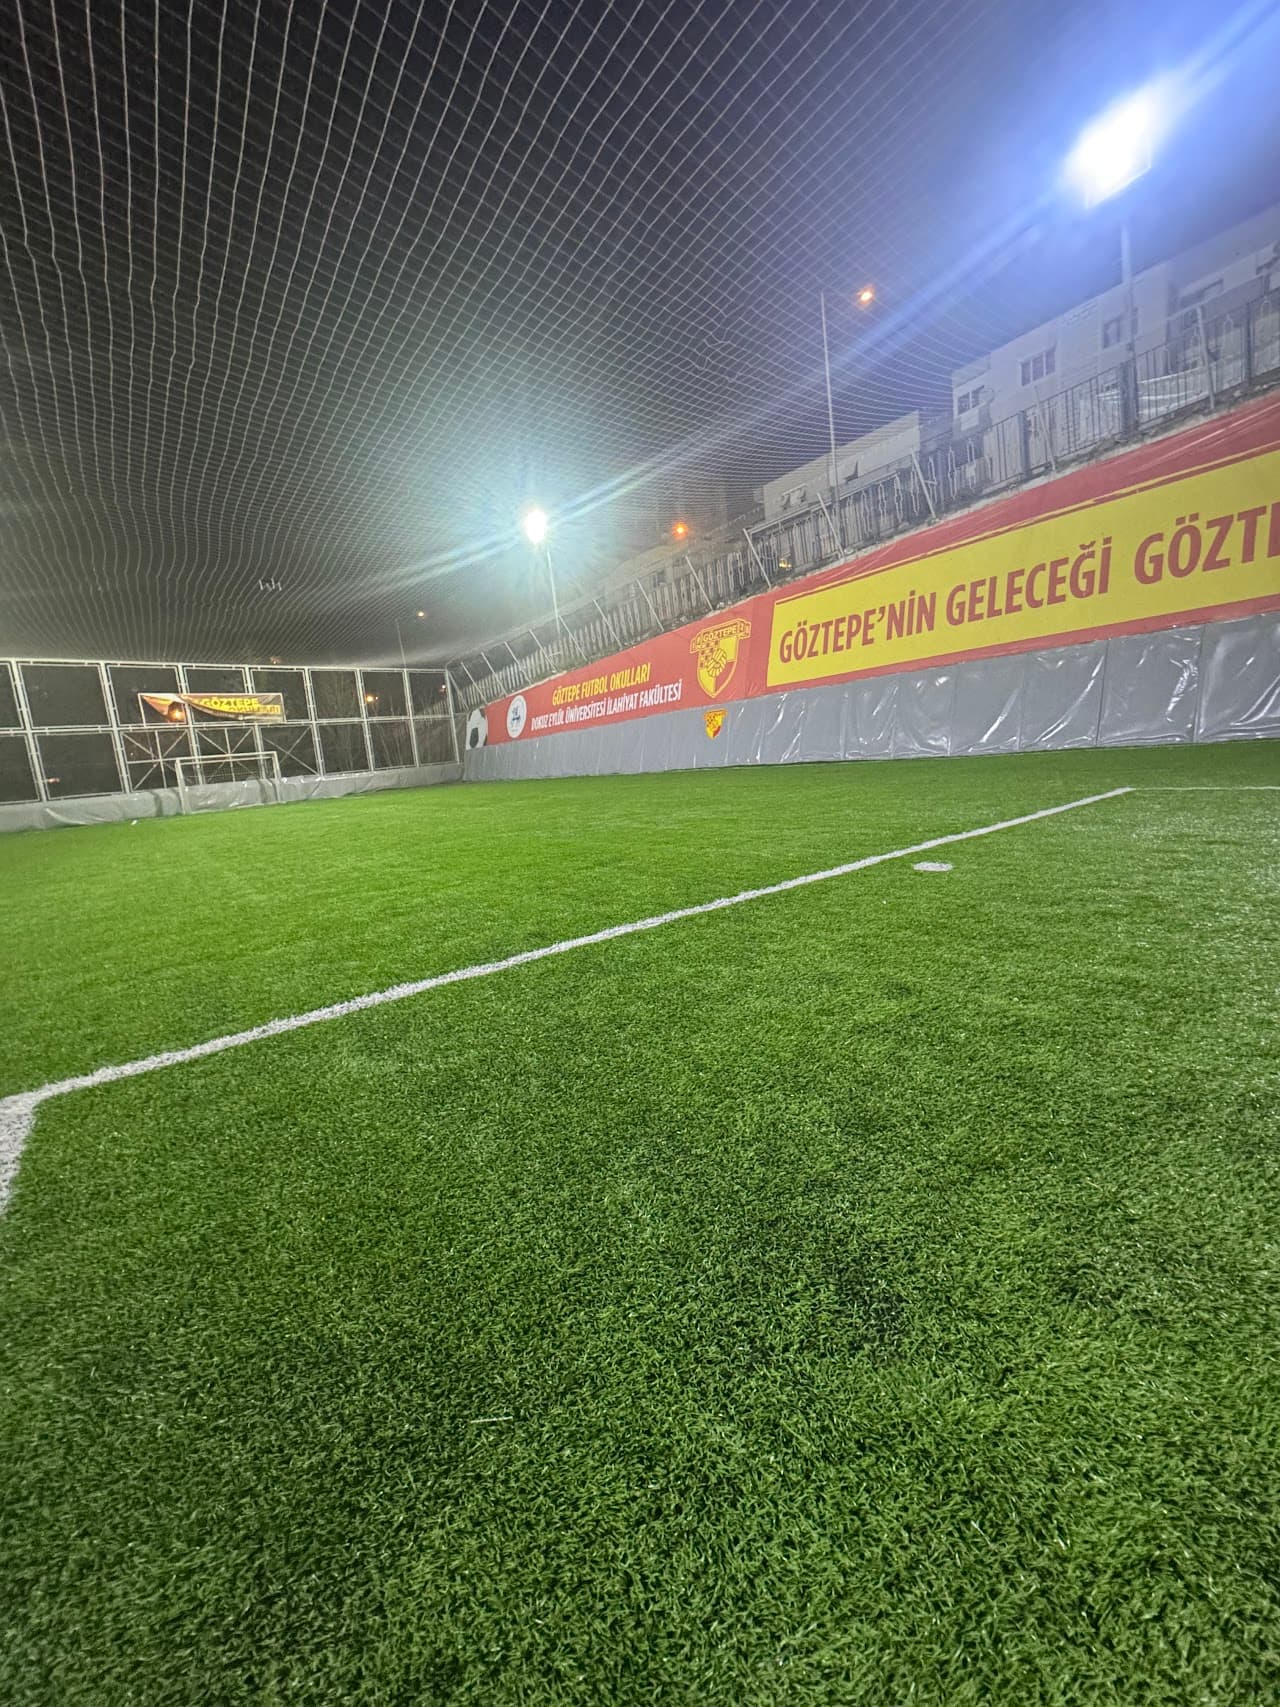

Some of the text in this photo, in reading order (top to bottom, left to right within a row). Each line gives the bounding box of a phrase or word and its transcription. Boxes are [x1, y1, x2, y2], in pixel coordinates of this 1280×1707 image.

[946, 536, 1112, 626] GELECEĞİ
[200, 696, 258, 707] GÖZTEPE
[531, 713, 549, 731] DOKUZ
[565, 697, 606, 724] ÜNİVERSİTESİ
[606, 692, 639, 716] İLAHİYAT
[639, 678, 682, 708] FAKÜLTESİ
[552, 662, 651, 706] GÖZTEPE FUTBOL OKULLARI
